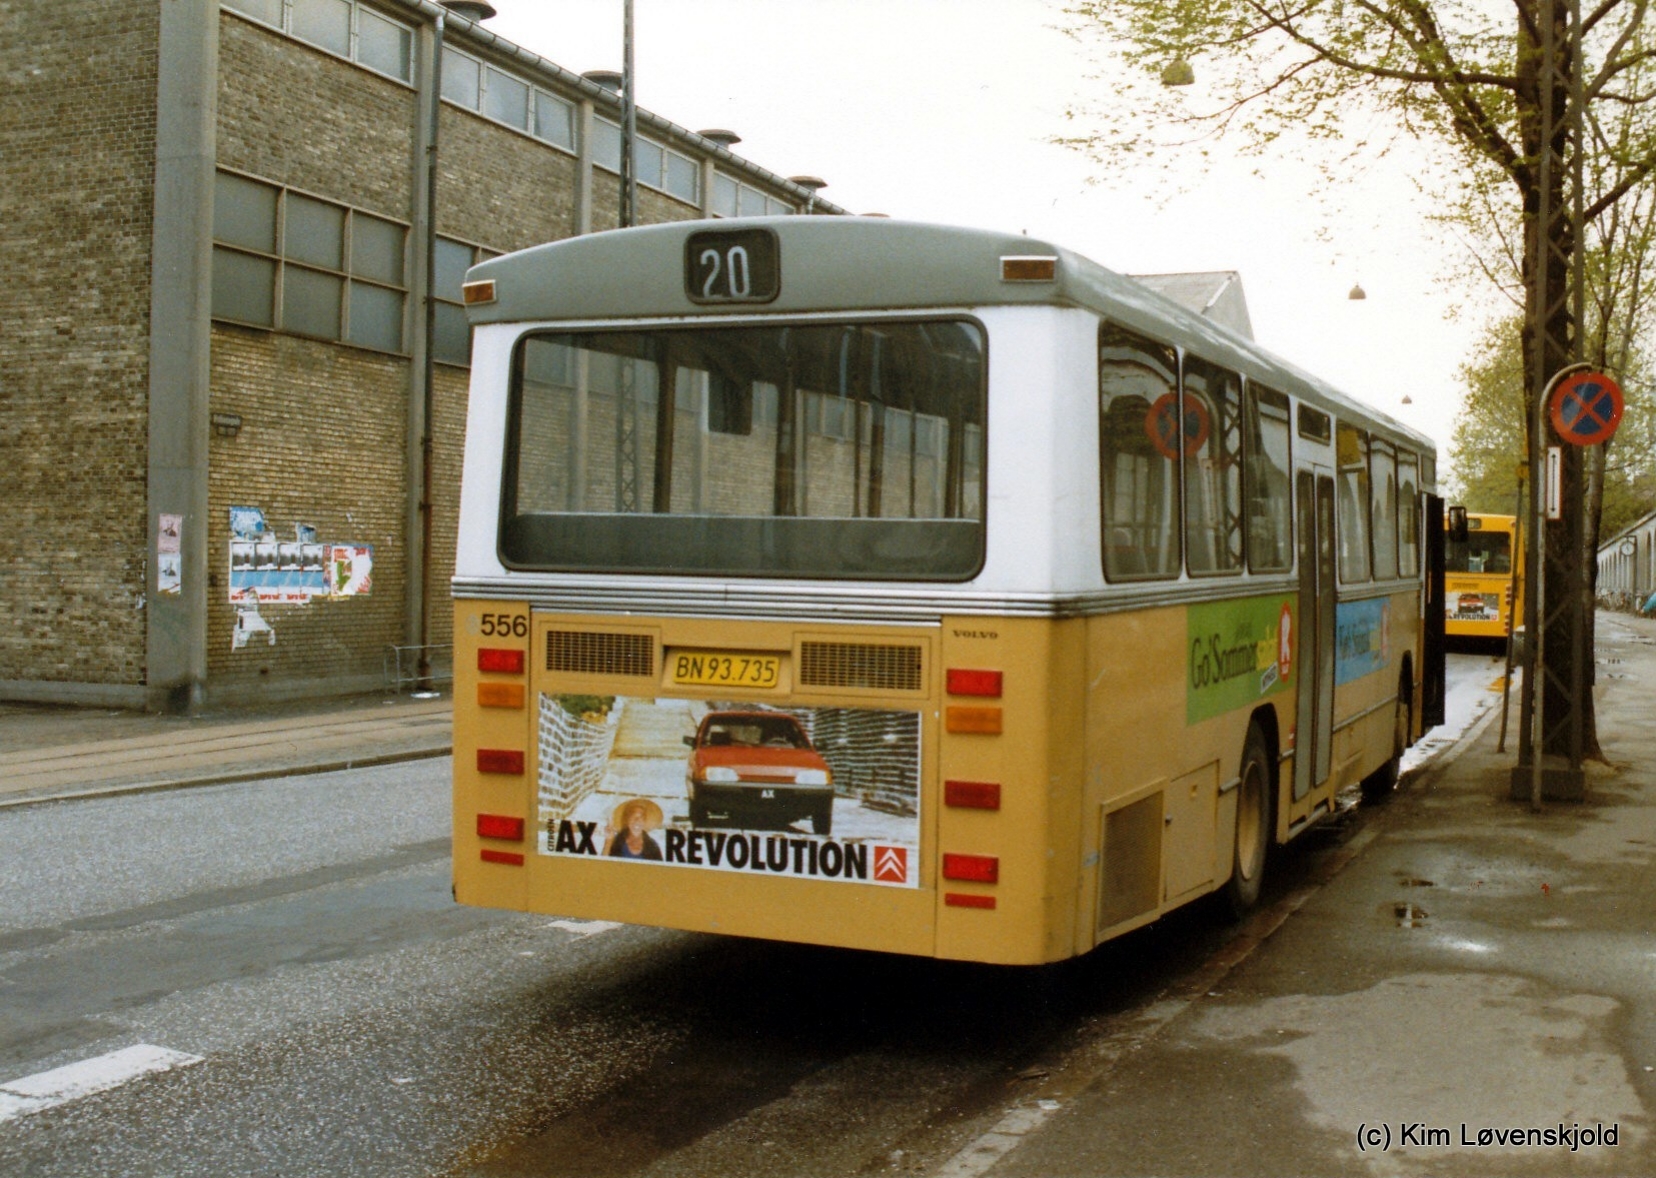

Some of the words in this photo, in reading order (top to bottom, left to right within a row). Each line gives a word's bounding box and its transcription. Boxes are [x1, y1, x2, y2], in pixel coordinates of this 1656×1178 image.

[701, 246, 750, 298] 20
[481, 613, 528, 638] 556
[953, 629, 999, 639] VOLVO
[676, 656, 705, 679] BN
[708, 657, 775, 682] 93.735
[761, 789, 775, 799] AX
[555, 819, 598, 855] AX
[665, 828, 868, 880] REVOLUTION
